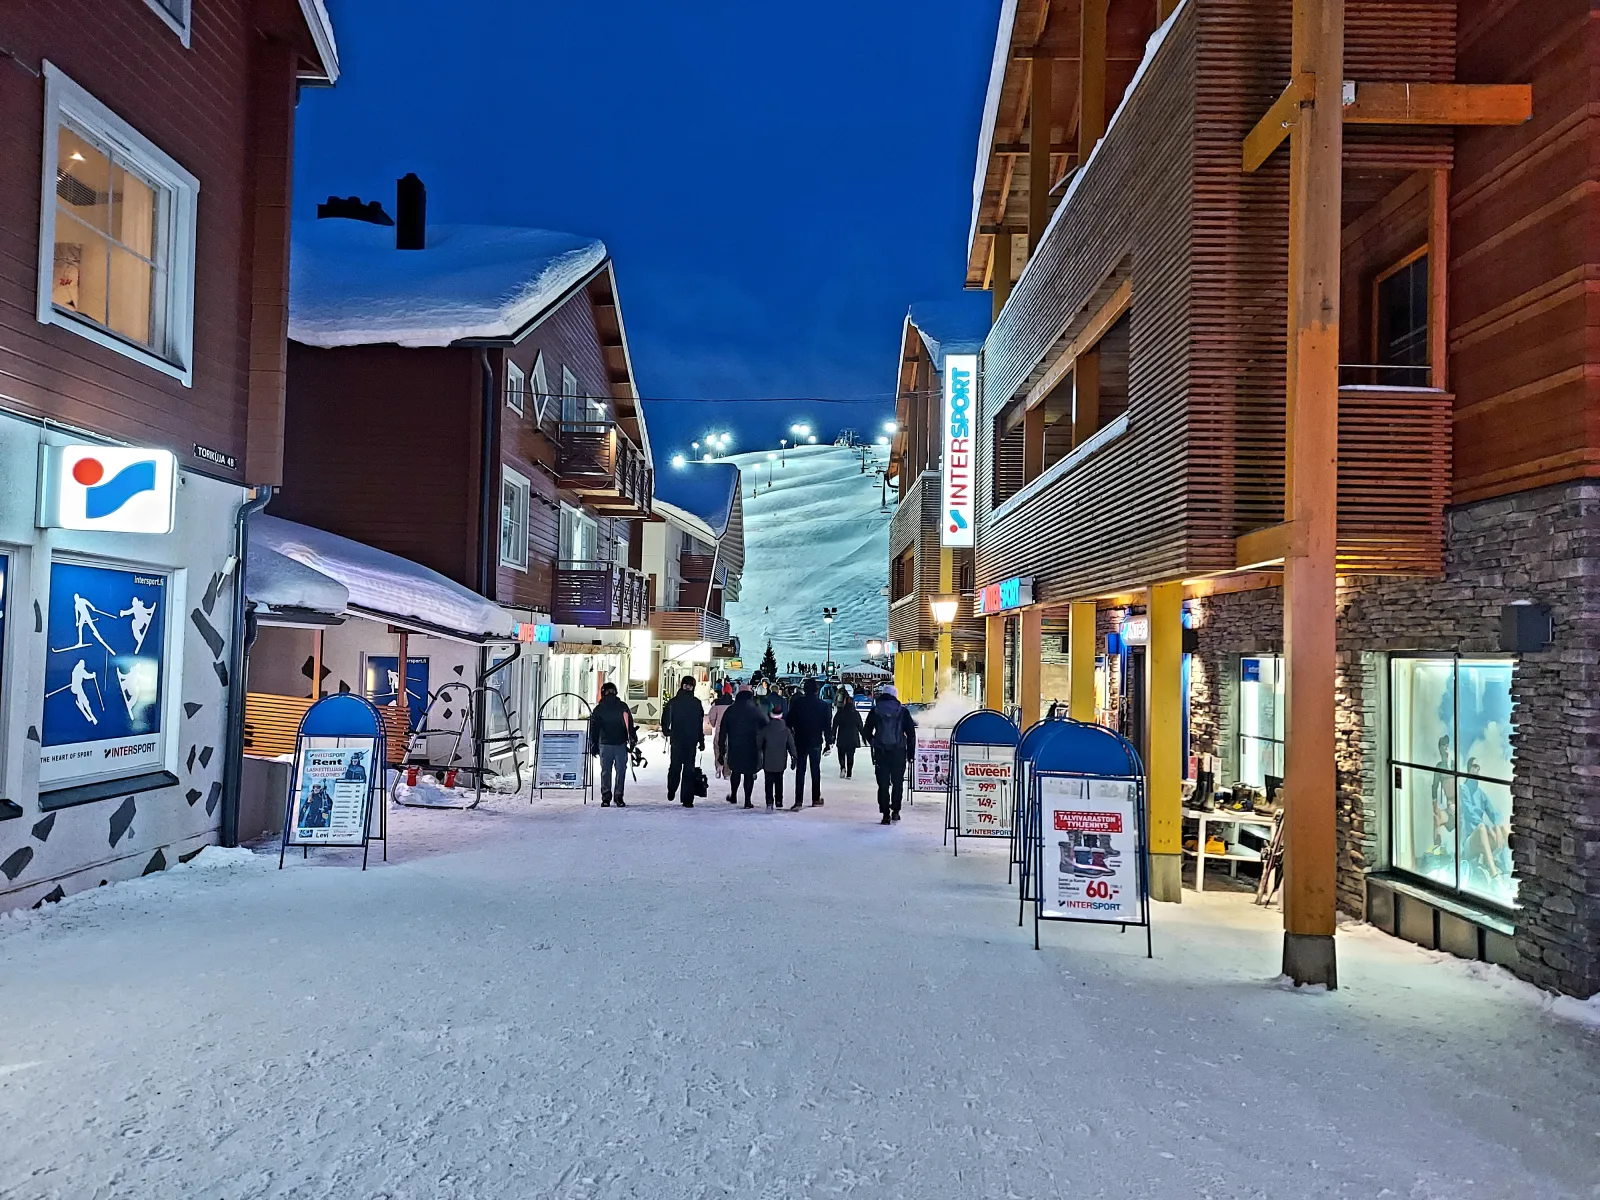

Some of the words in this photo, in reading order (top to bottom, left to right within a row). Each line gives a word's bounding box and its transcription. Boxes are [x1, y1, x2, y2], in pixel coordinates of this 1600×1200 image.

[950, 367, 970, 505] INTERSPORT
[198, 446, 226, 465] TORIKUJA
[51, 754, 68, 762] HEART
[77, 750, 93, 759] SPORT
[111, 742, 156, 758] INTERSPORT
[964, 765, 1011, 777] talveen!
[1059, 815, 1116, 823] TALVIVARASTON
[1067, 821, 1109, 829] TYHJENNYS
[1086, 880, 1120, 901] 60,-
[1066, 900, 1122, 911] INTERSPORT
